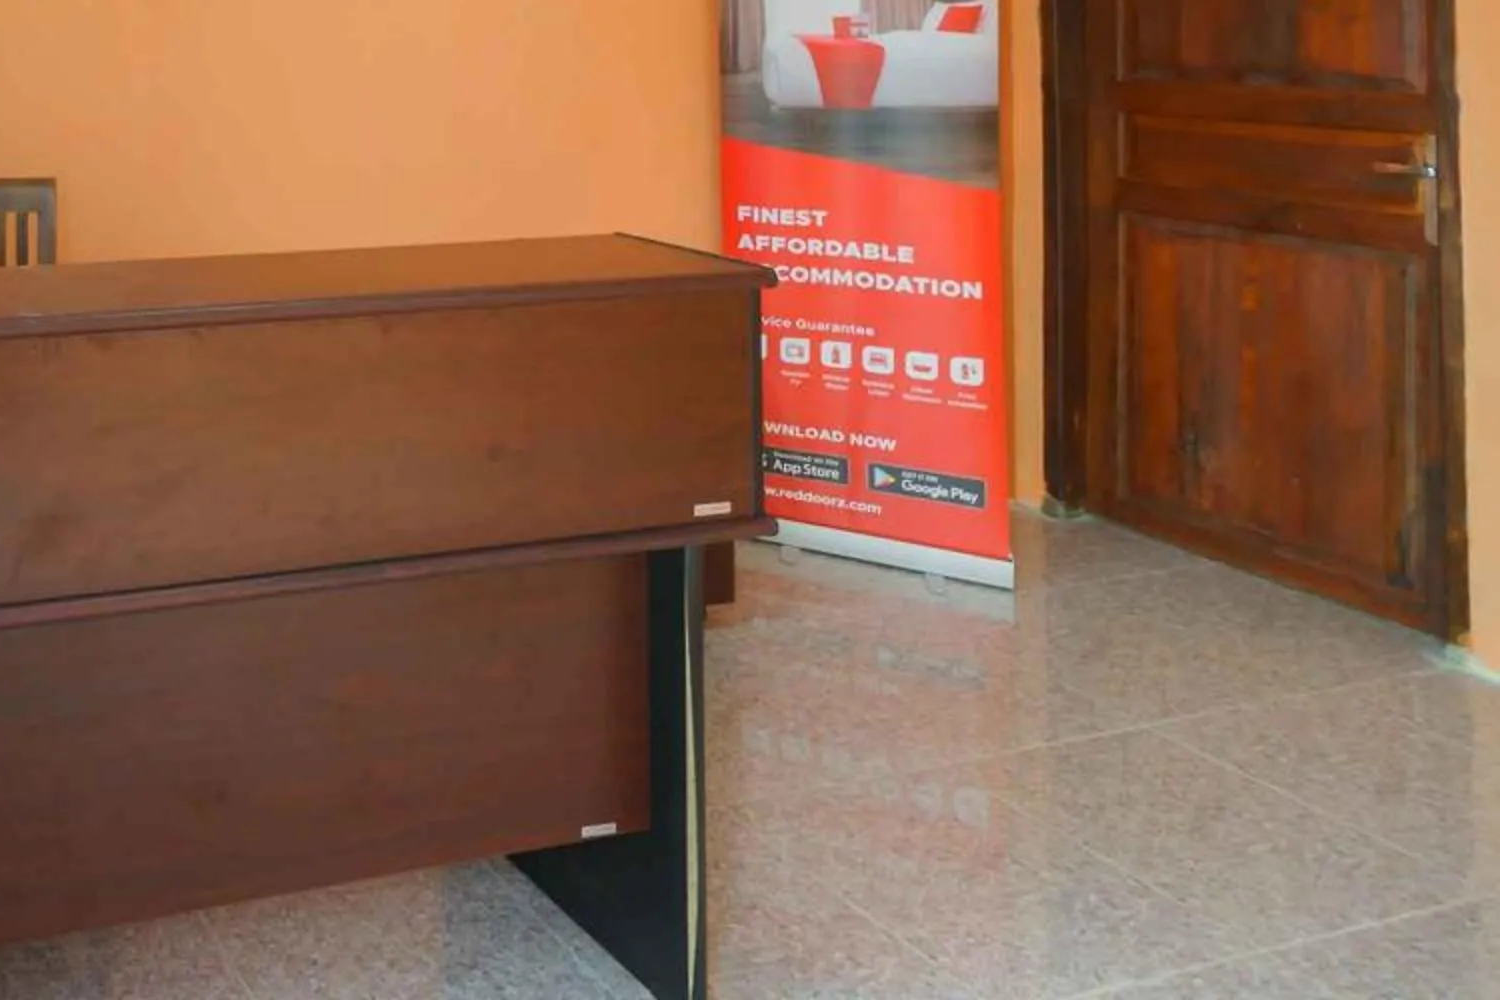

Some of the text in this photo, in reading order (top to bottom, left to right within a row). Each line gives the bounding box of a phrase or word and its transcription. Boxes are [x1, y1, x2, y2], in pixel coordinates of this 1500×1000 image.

[736, 204, 829, 228] FINEST
[737, 233, 916, 264] AFFORDABLE
[762, 263, 984, 300] COMMODATION
[761, 315, 792, 329] vice
[764, 420, 897, 452] WNLOAD NOW
[773, 459, 840, 480] App Store
[764, 487, 883, 516] w.reddoorz.com
[901, 479, 980, 505] Google Play
